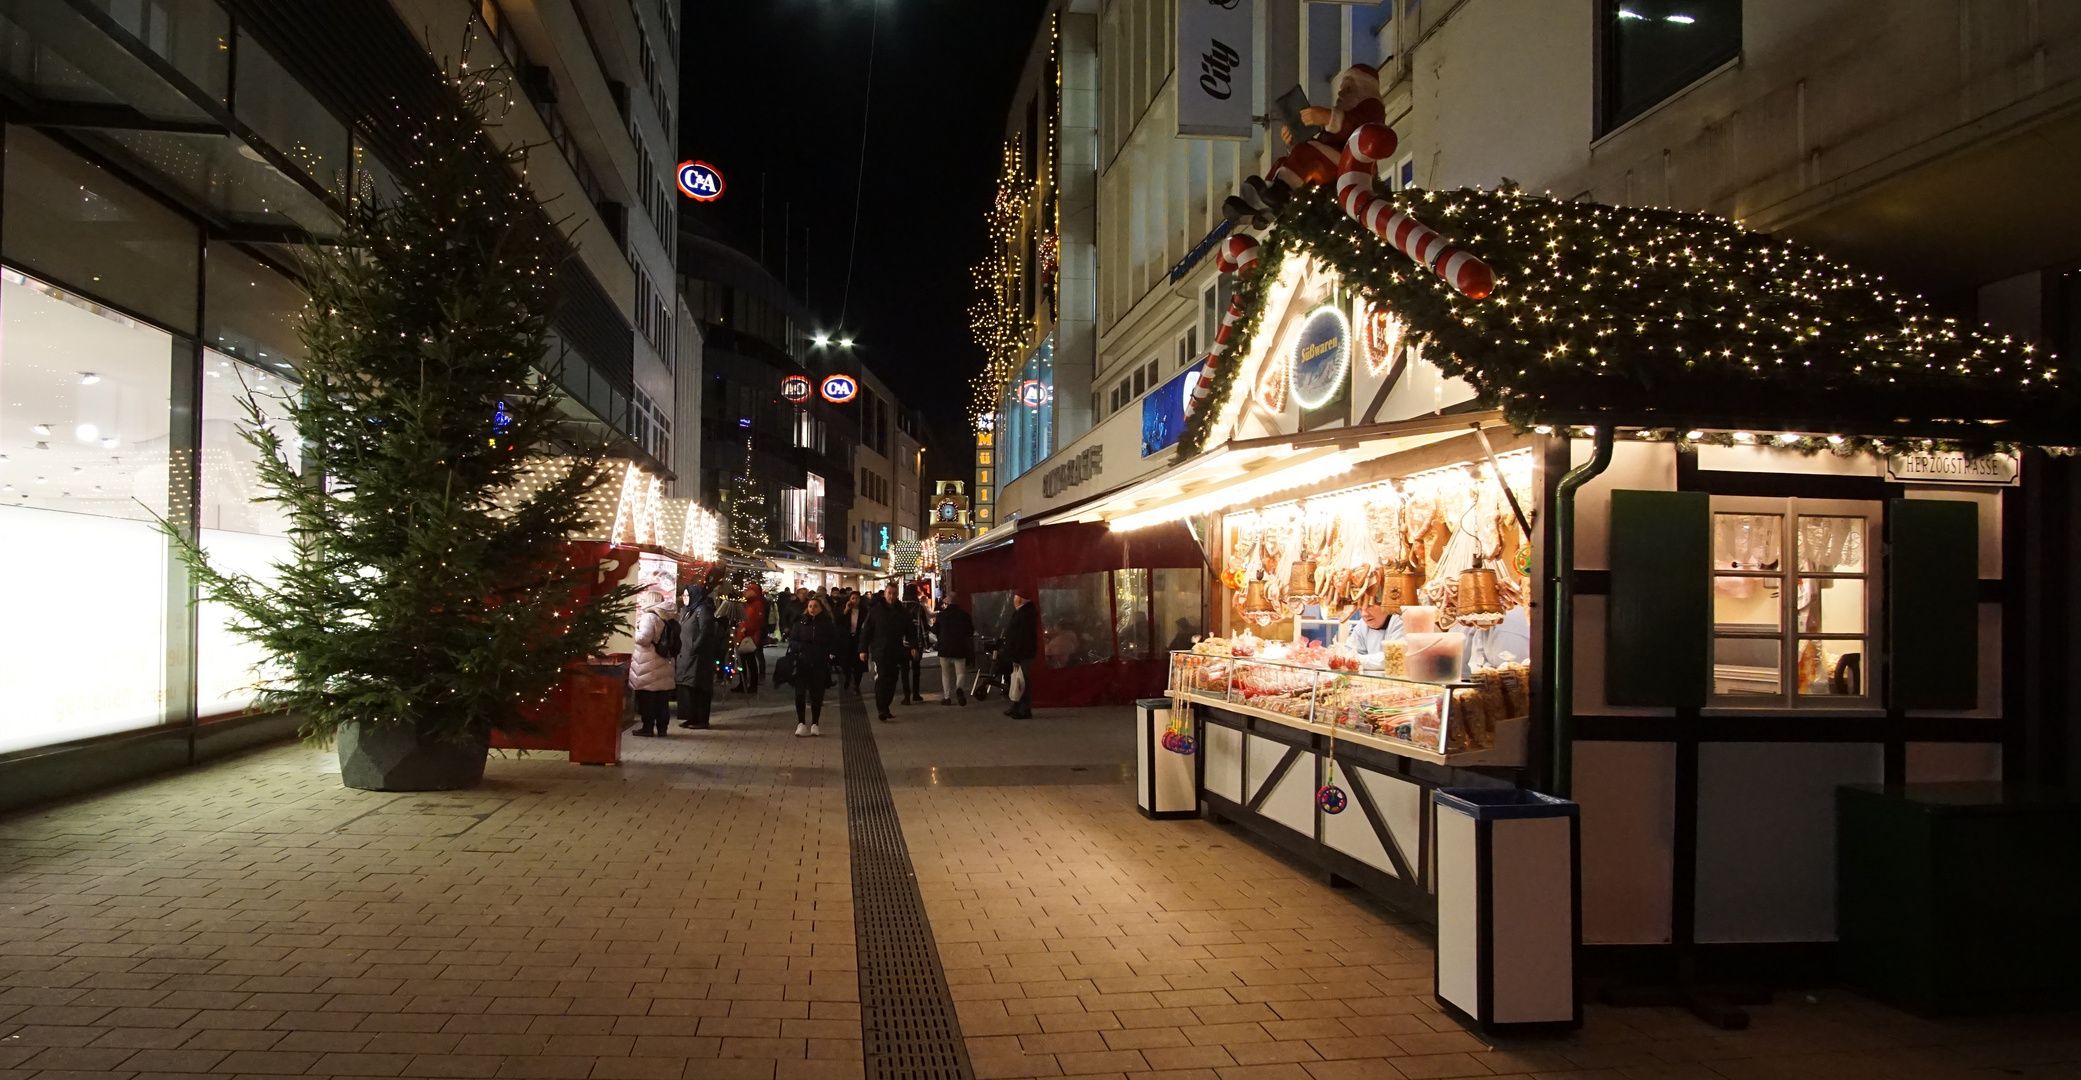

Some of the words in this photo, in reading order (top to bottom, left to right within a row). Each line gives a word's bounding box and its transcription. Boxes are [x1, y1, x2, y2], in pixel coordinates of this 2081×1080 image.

[1200, 38, 1240, 100] City
[684, 169, 717, 193] C&A
[1301, 336, 1338, 364] Süßwaren
[826, 382, 850, 395] C&A
[1906, 456, 1998, 476] HERZOGSTRASSE
[978, 433, 993, 536] Müller
